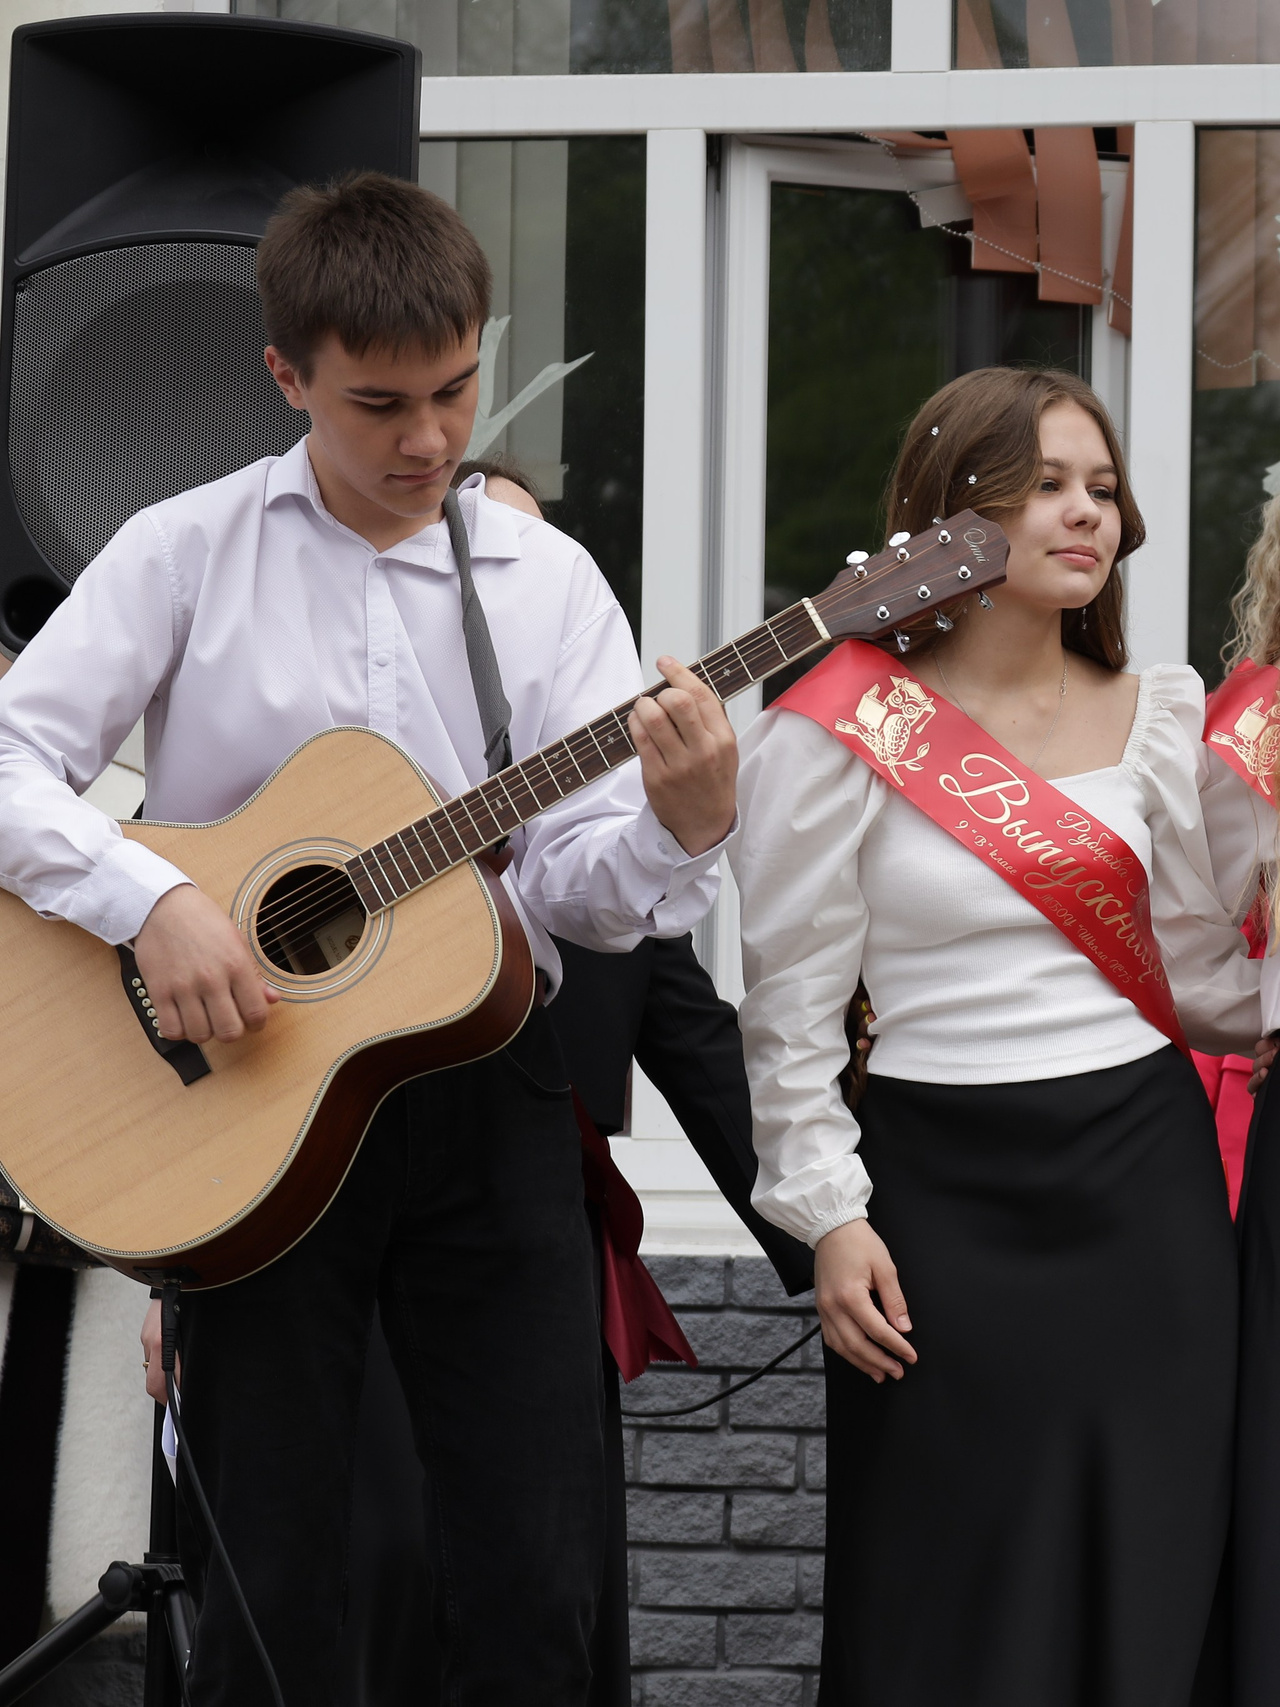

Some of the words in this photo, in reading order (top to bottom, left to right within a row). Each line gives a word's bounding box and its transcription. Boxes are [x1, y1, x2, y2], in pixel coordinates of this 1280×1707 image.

[938, 753, 1167, 989] Выпускница
[955, 820, 969, 830] 9
[988, 848, 1017, 876] класс
[1036, 894, 1077, 927] МБОУ
[1056, 811, 1134, 879] Рубцова
